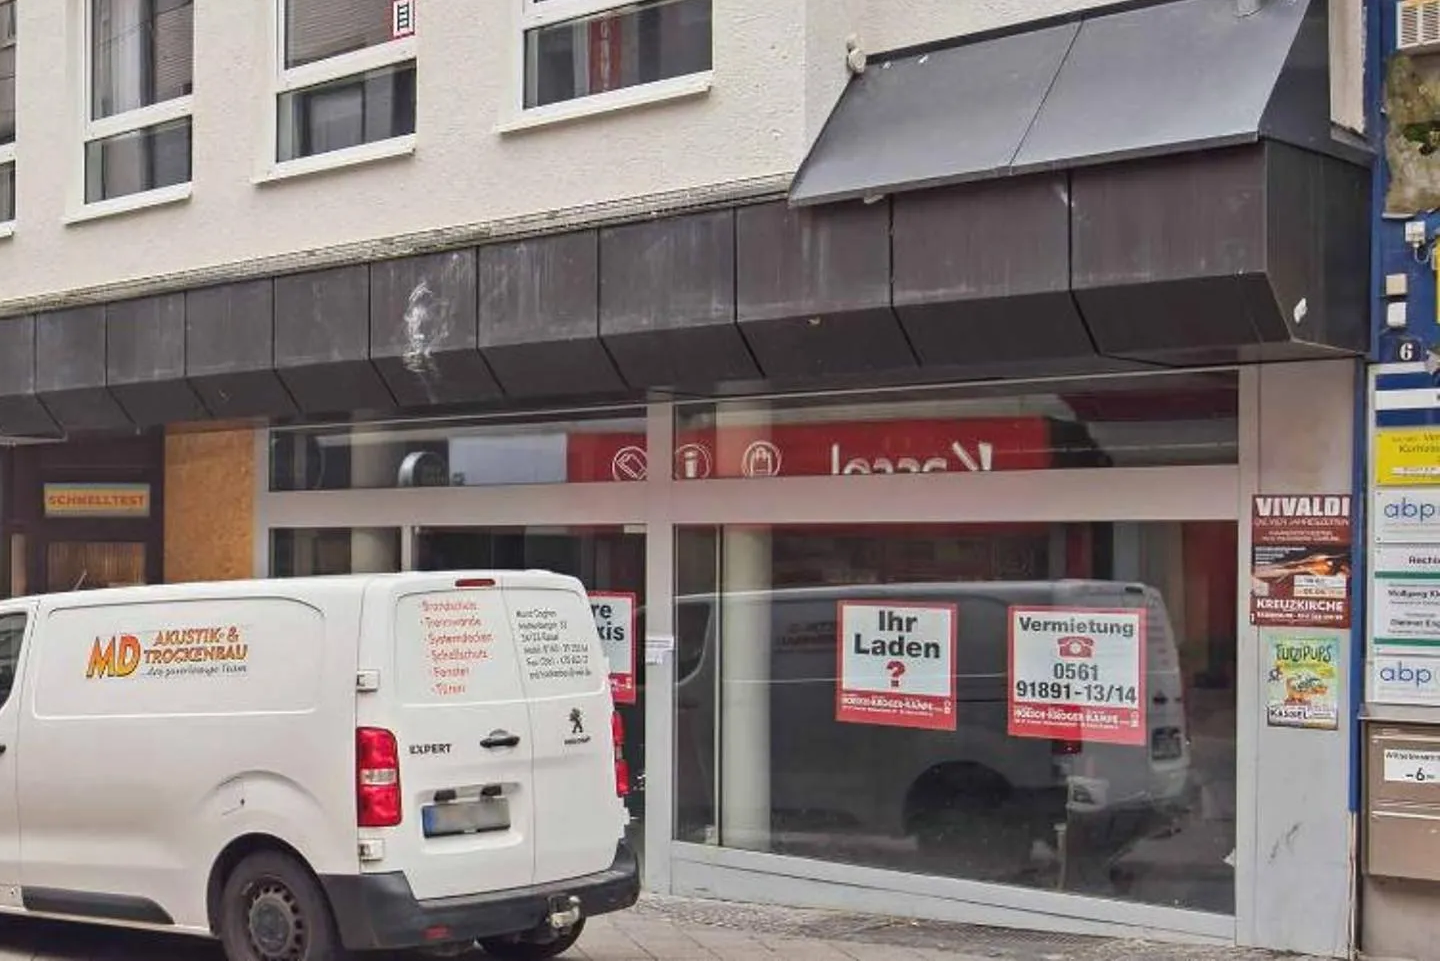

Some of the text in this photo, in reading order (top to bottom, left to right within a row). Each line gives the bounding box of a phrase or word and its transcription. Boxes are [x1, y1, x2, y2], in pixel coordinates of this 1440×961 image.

[1399, 342, 1413, 361] 6
[48, 494, 144, 507] SCHNELLTEST
[1255, 497, 1351, 517] VIVALDI
[1383, 497, 1436, 522] abp
[1256, 598, 1345, 612] KREUZKIRCHE
[878, 610, 918, 633] Ihr
[1018, 616, 1134, 639] Vermietung
[226, 626, 240, 643] &
[86, 634, 142, 679] MD
[143, 644, 248, 665] TROCKENBAU
[853, 634, 941, 659] Laden
[886, 661, 906, 688] ?
[1053, 663, 1100, 682] 0561
[1380, 660, 1432, 688] abp
[1016, 680, 1138, 704] 91891-13/14
[409, 743, 452, 755] EXPERT
